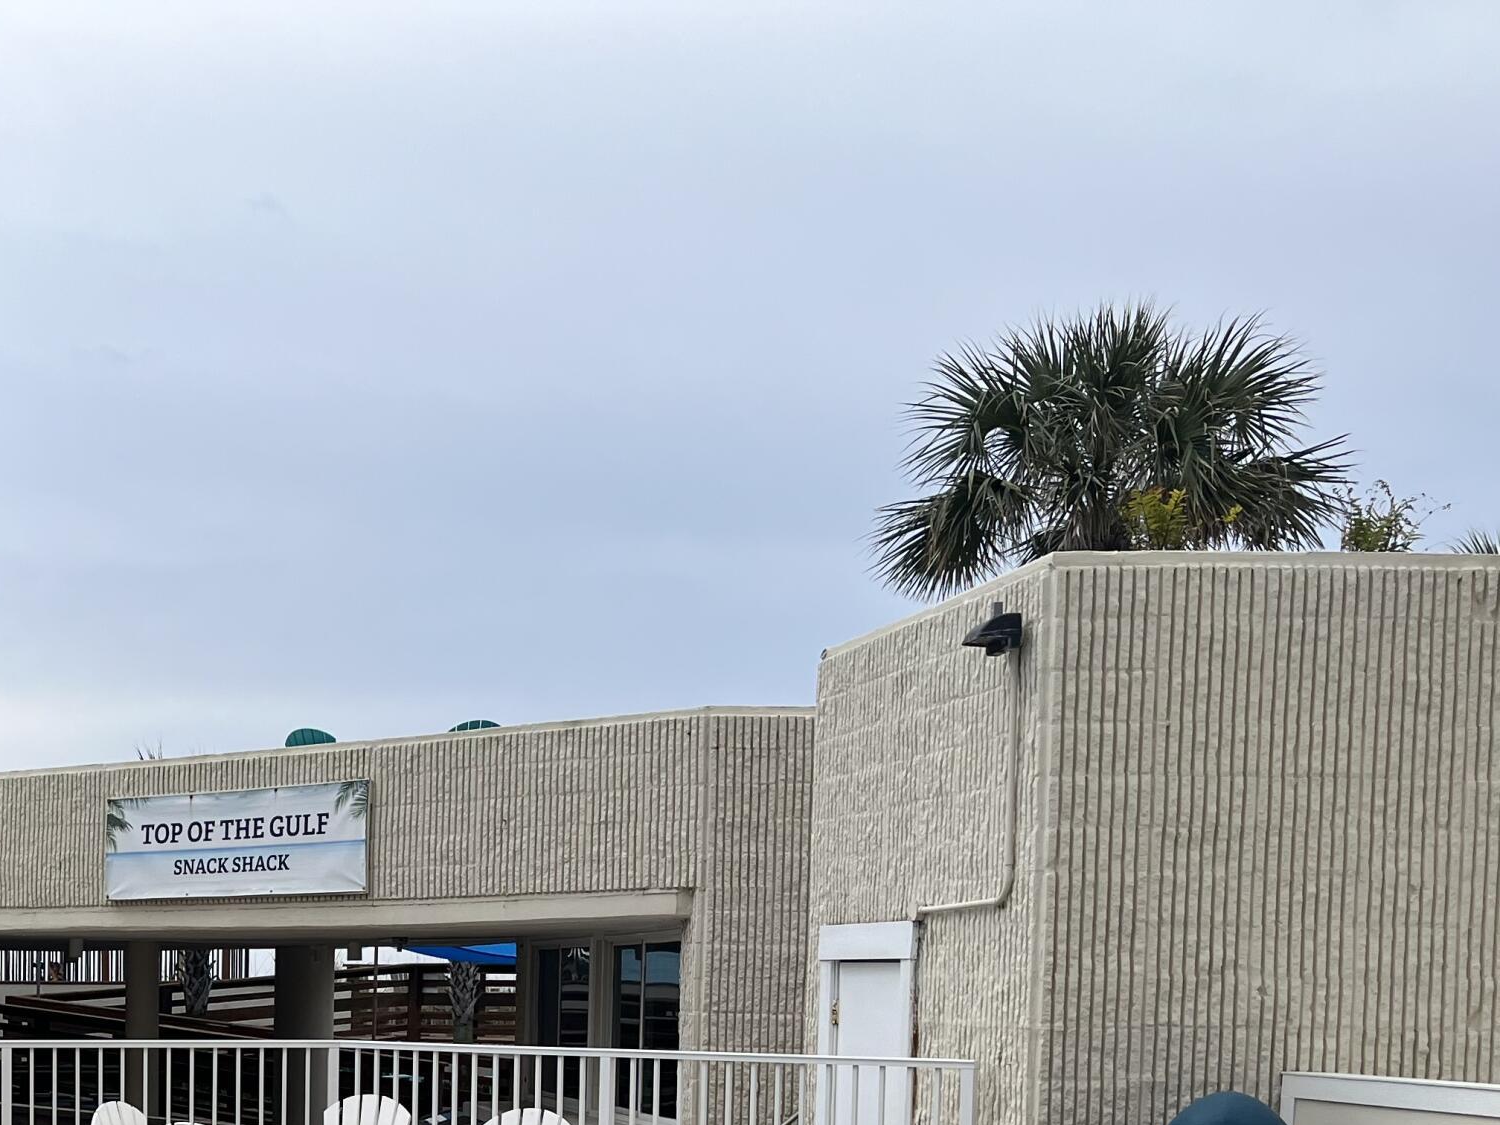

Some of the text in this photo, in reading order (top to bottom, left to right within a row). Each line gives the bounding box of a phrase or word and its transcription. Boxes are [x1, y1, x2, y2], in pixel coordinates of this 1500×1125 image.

[141, 812, 330, 845] TOP OF THE GULF
[173, 854, 290, 876] SNACK SHACK
